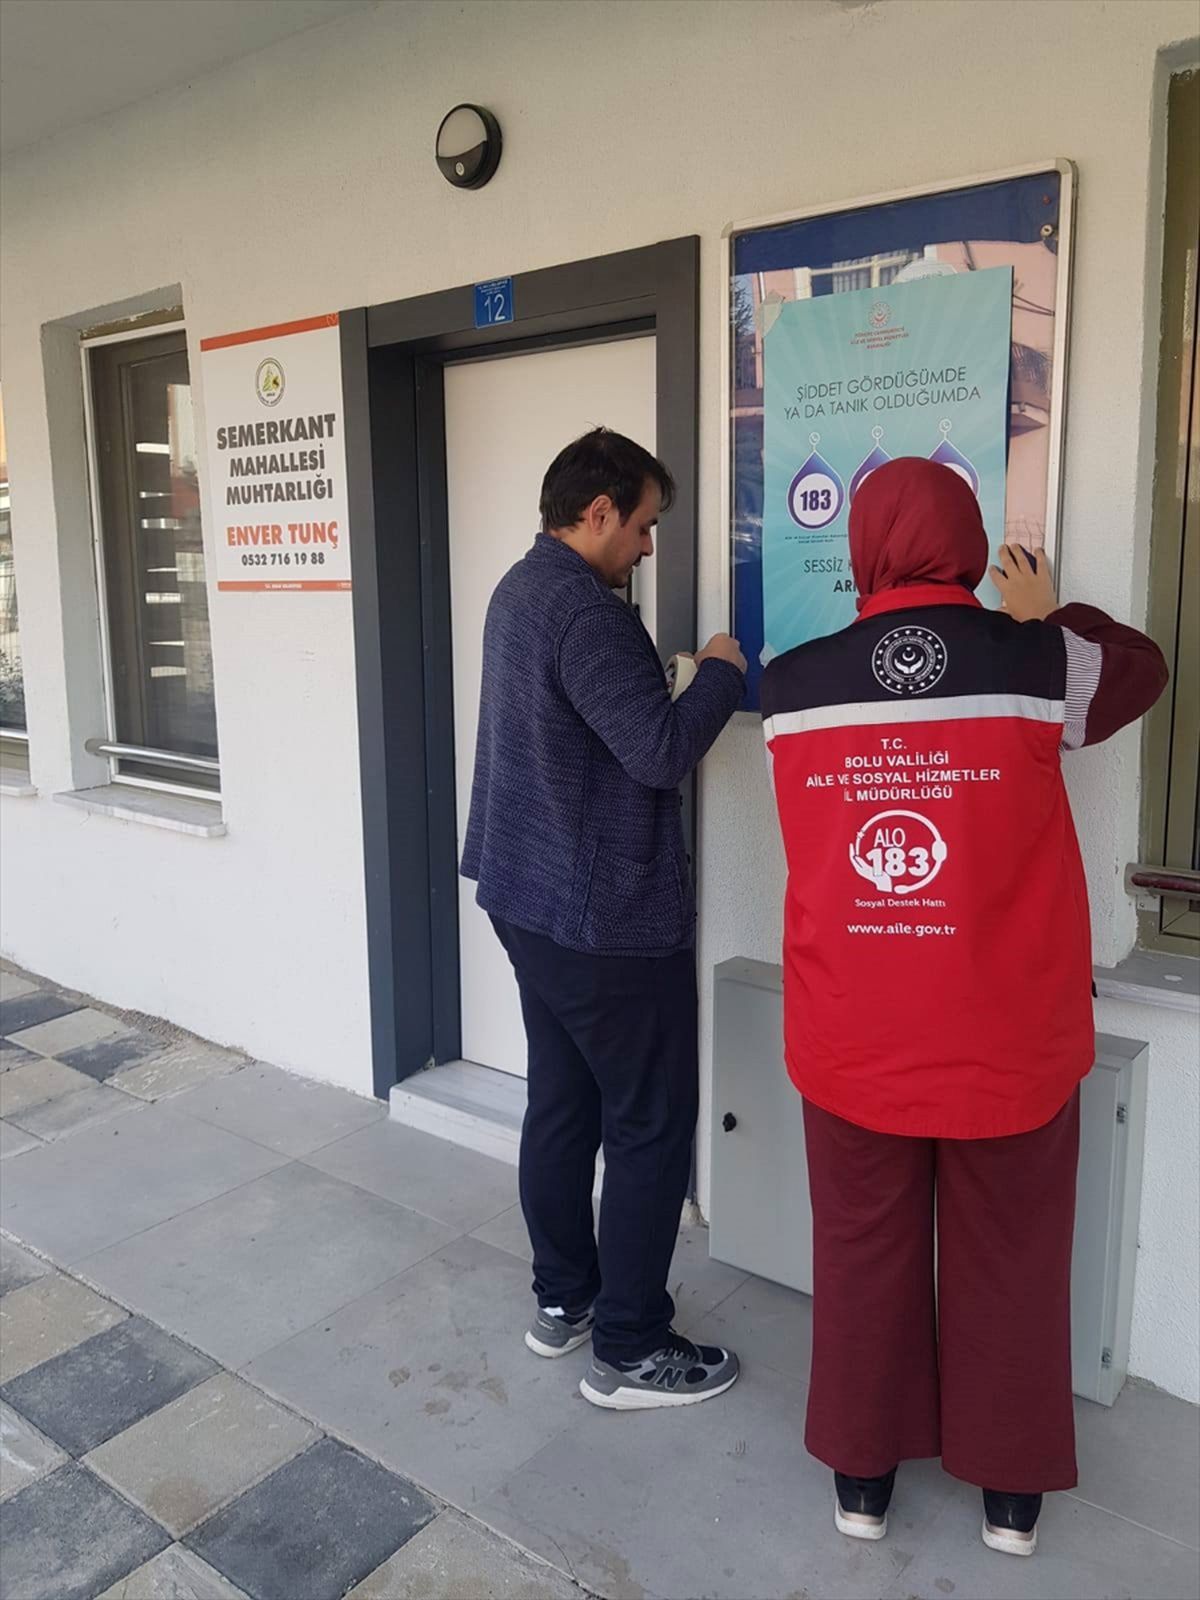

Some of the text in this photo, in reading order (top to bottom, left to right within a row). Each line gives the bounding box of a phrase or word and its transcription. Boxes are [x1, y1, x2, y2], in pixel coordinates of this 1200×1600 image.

[484, 293, 506, 322] 12
[797, 366, 967, 402] ŞİDDET GÖRDÜĞÜMDE
[784, 386, 981, 420] YA DA TANIK OLDUĞUMDA
[216, 413, 336, 450] SEMERKANT
[230, 443, 325, 477] MAHALLESİ
[226, 473, 333, 505] MUHTARLIĞI
[800, 489, 832, 511] 183
[226, 521, 338, 549] ENVER TUNÇ
[241, 552, 325, 566] 0532 716 19 88
[803, 557, 843, 573] SESSİZ
[880, 737, 907, 750] T.C.
[844, 751, 949, 768] BOLU VALİLİĞİ
[805, 768, 1000, 788] AİLE VE SOSYAL HİZMETLER
[843, 785, 953, 802] İL MÜDÜRLÜĞÜ
[874, 827, 906, 848] ALO
[866, 847, 930, 877] 183
[855, 898, 885, 908] Sosyal
[887, 898, 920, 907] Destek
[847, 923, 956, 936] www.aile.gov.tr
[654, 1364, 685, 1391] N
